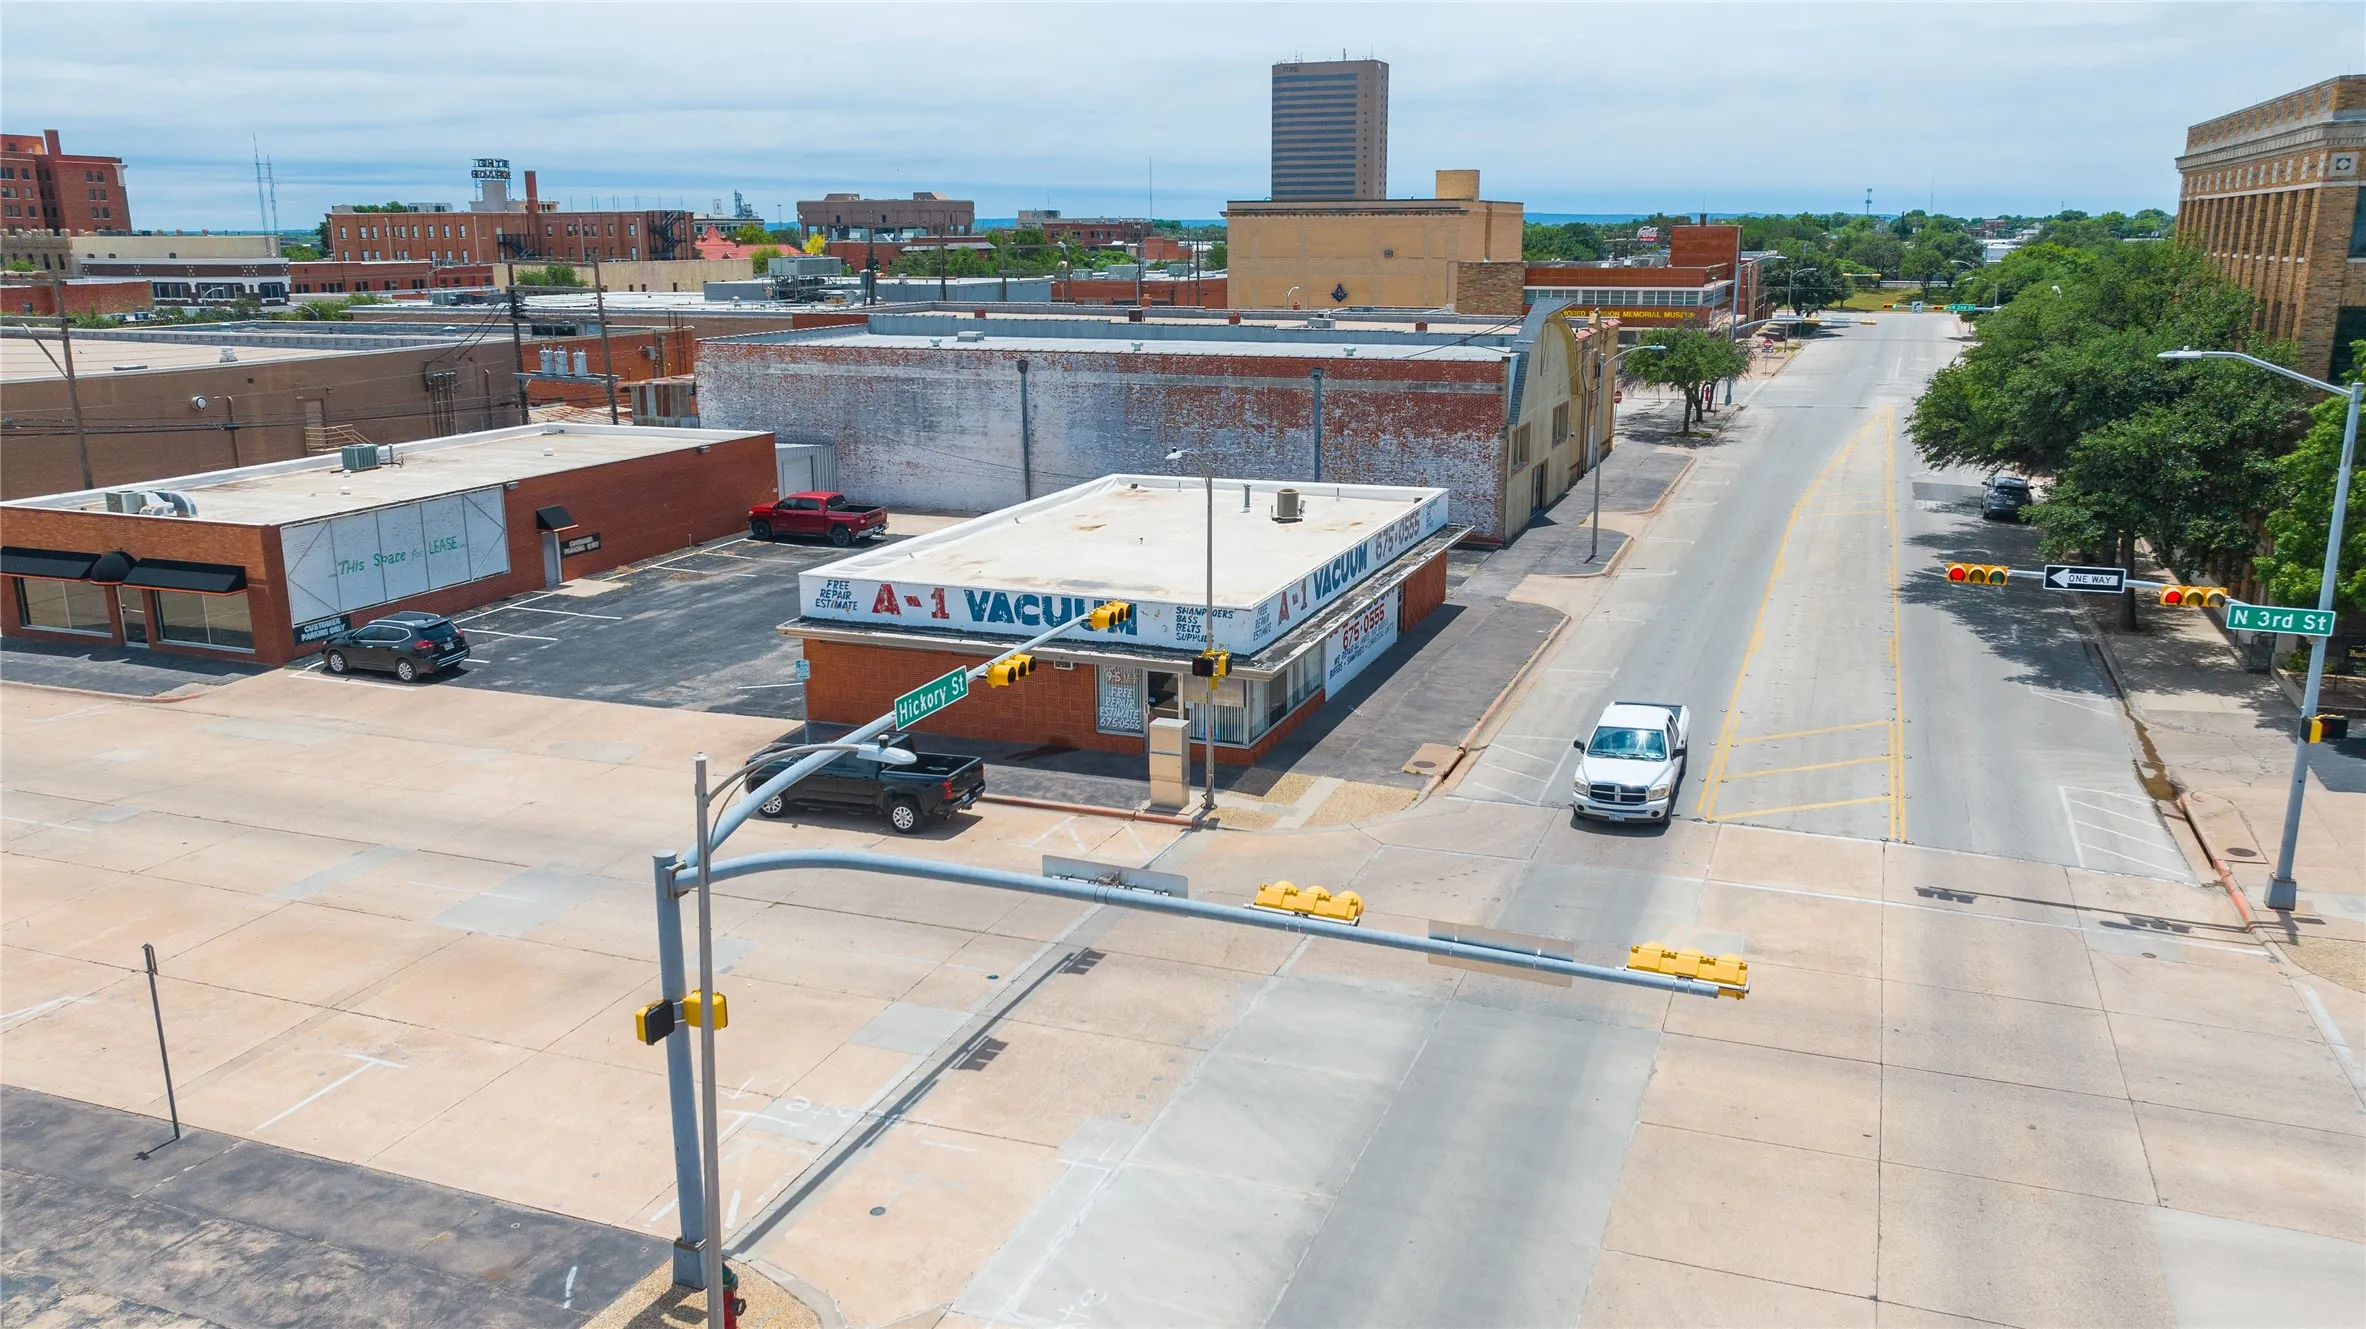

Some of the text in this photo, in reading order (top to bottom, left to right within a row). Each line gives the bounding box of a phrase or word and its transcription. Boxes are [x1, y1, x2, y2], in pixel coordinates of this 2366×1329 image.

[428, 536, 458, 555] LEASE
[1313, 541, 1368, 600] VACUUM
[827, 579, 850, 590] FREE
[2068, 574, 2112, 584] ONE WAY
[820, 589, 851, 600] REPAIR
[815, 599, 858, 610] ESTIMATE
[1176, 606, 1234, 619] SHAMPOERS
[304, 617, 341, 633] CUSTOMER
[2234, 609, 2327, 631] N 3rd St
[301, 623, 346, 641] PARKING ONLY
[1176, 623, 1201, 633] BELTS
[899, 674, 965, 723] Hickory St
[1111, 687, 1133, 699] FREE
[1105, 697, 1135, 709] REPAIR
[1100, 707, 1140, 720] ESTIMATE
